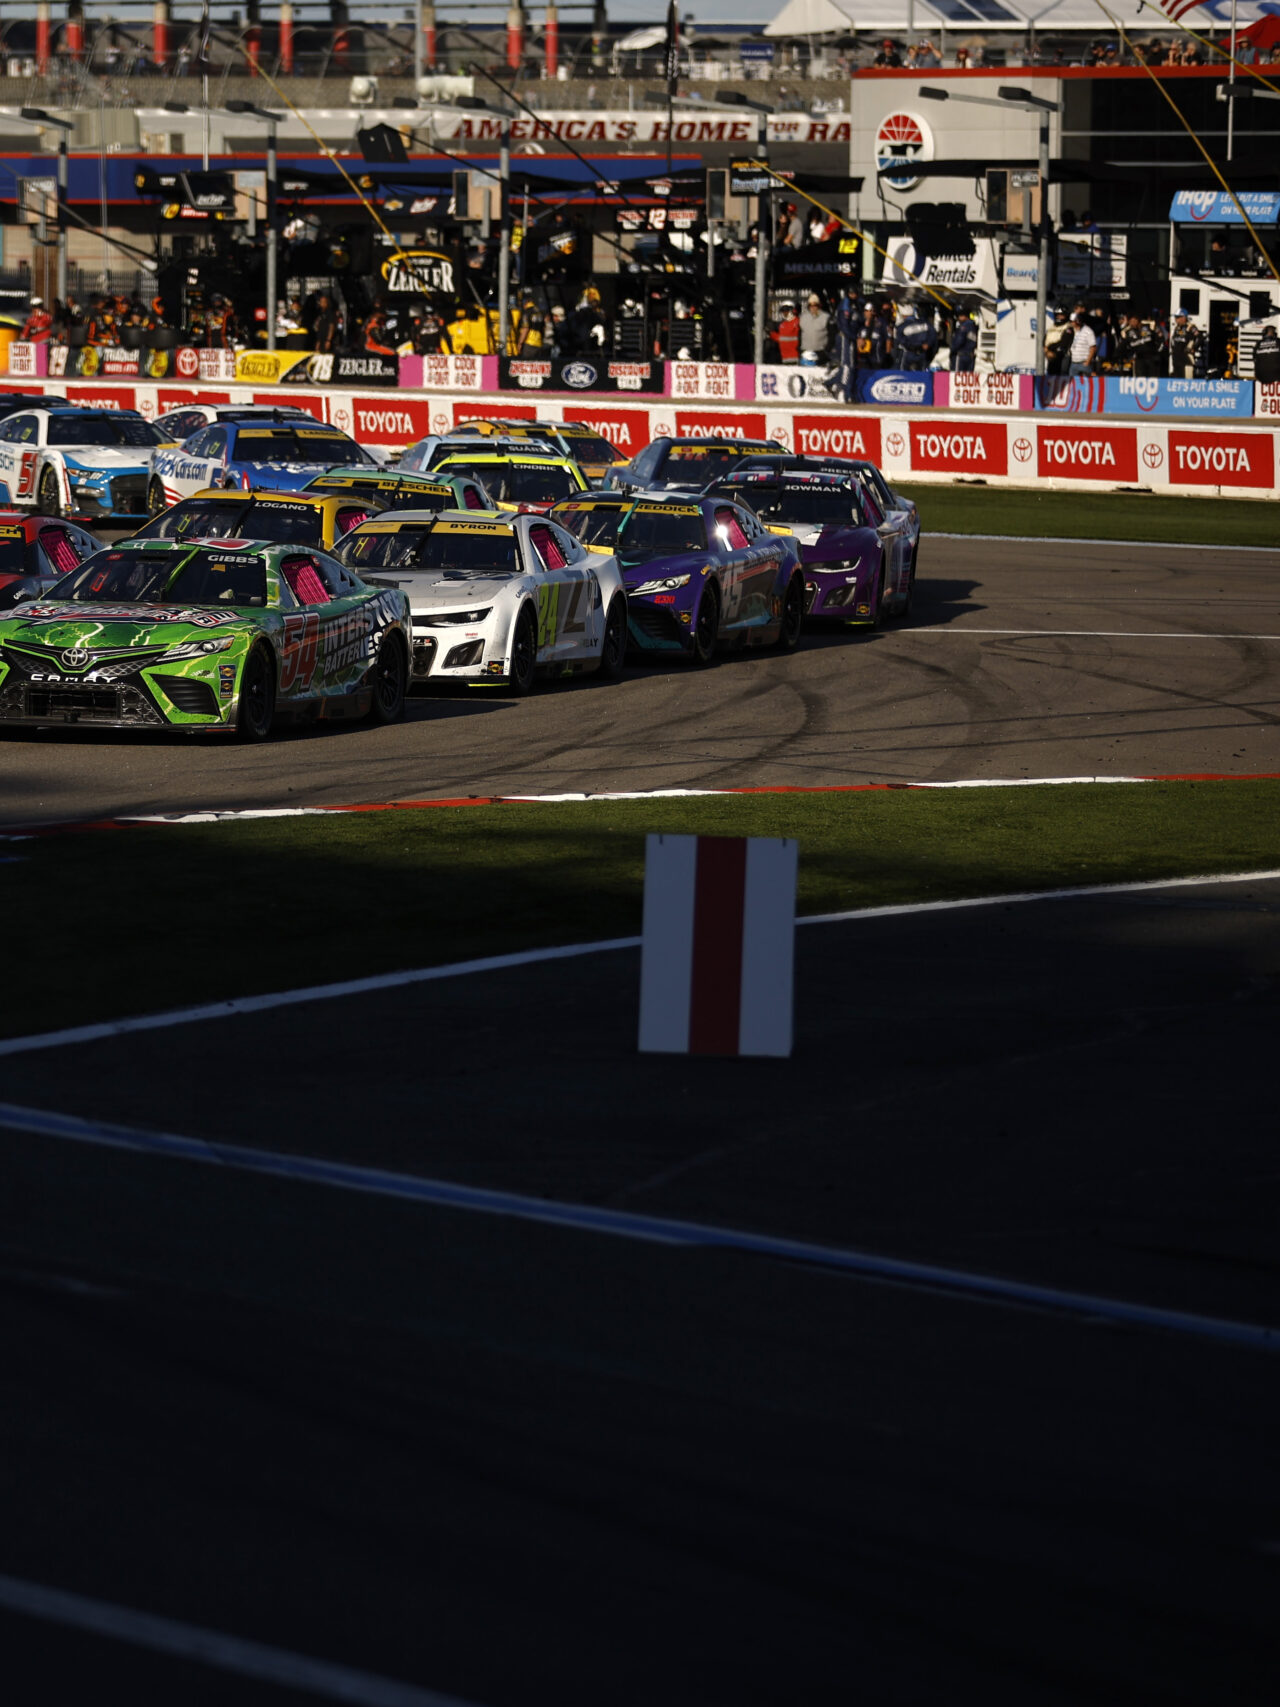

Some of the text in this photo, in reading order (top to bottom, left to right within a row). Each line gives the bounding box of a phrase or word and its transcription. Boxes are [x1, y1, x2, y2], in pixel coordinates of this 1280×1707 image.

[453, 119, 638, 140] AMERICA'S
[651, 121, 751, 141] HOME
[784, 262, 851, 274] MENARDS
[926, 264, 976, 283] Rentals
[311, 353, 334, 381] 78
[427, 355, 476, 370] COOK COOK
[675, 364, 729, 379] COOK COOK
[954, 371, 1014, 389] COOK COOK
[1167, 381, 1187, 393] LET'S
[1189, 382, 1204, 393] PUT
[1206, 382, 1213, 393] A
[1215, 382, 1240, 393] SMILE
[962, 389, 1013, 405] OUT OUT
[1173, 398, 1236, 409] ON YOUR PLATE
[358, 410, 414, 434] TOYOTA
[798, 429, 866, 454] TOYOTA
[917, 434, 987, 460] TOYOTA
[1044, 440, 1115, 466] TOYOTA
[1176, 446, 1251, 472] TOYOTA
[513, 463, 557, 472] CINDRIC
[382, 481, 451, 493] BUESCHER
[254, 501, 308, 511] LOGANO
[637, 503, 697, 514] REDDICK
[450, 523, 497, 531] BYRON
[208, 554, 258, 564] GIBBS
[537, 581, 560, 647] 24
[280, 612, 320, 690] 54
[323, 631, 384, 676] BATTERIES
